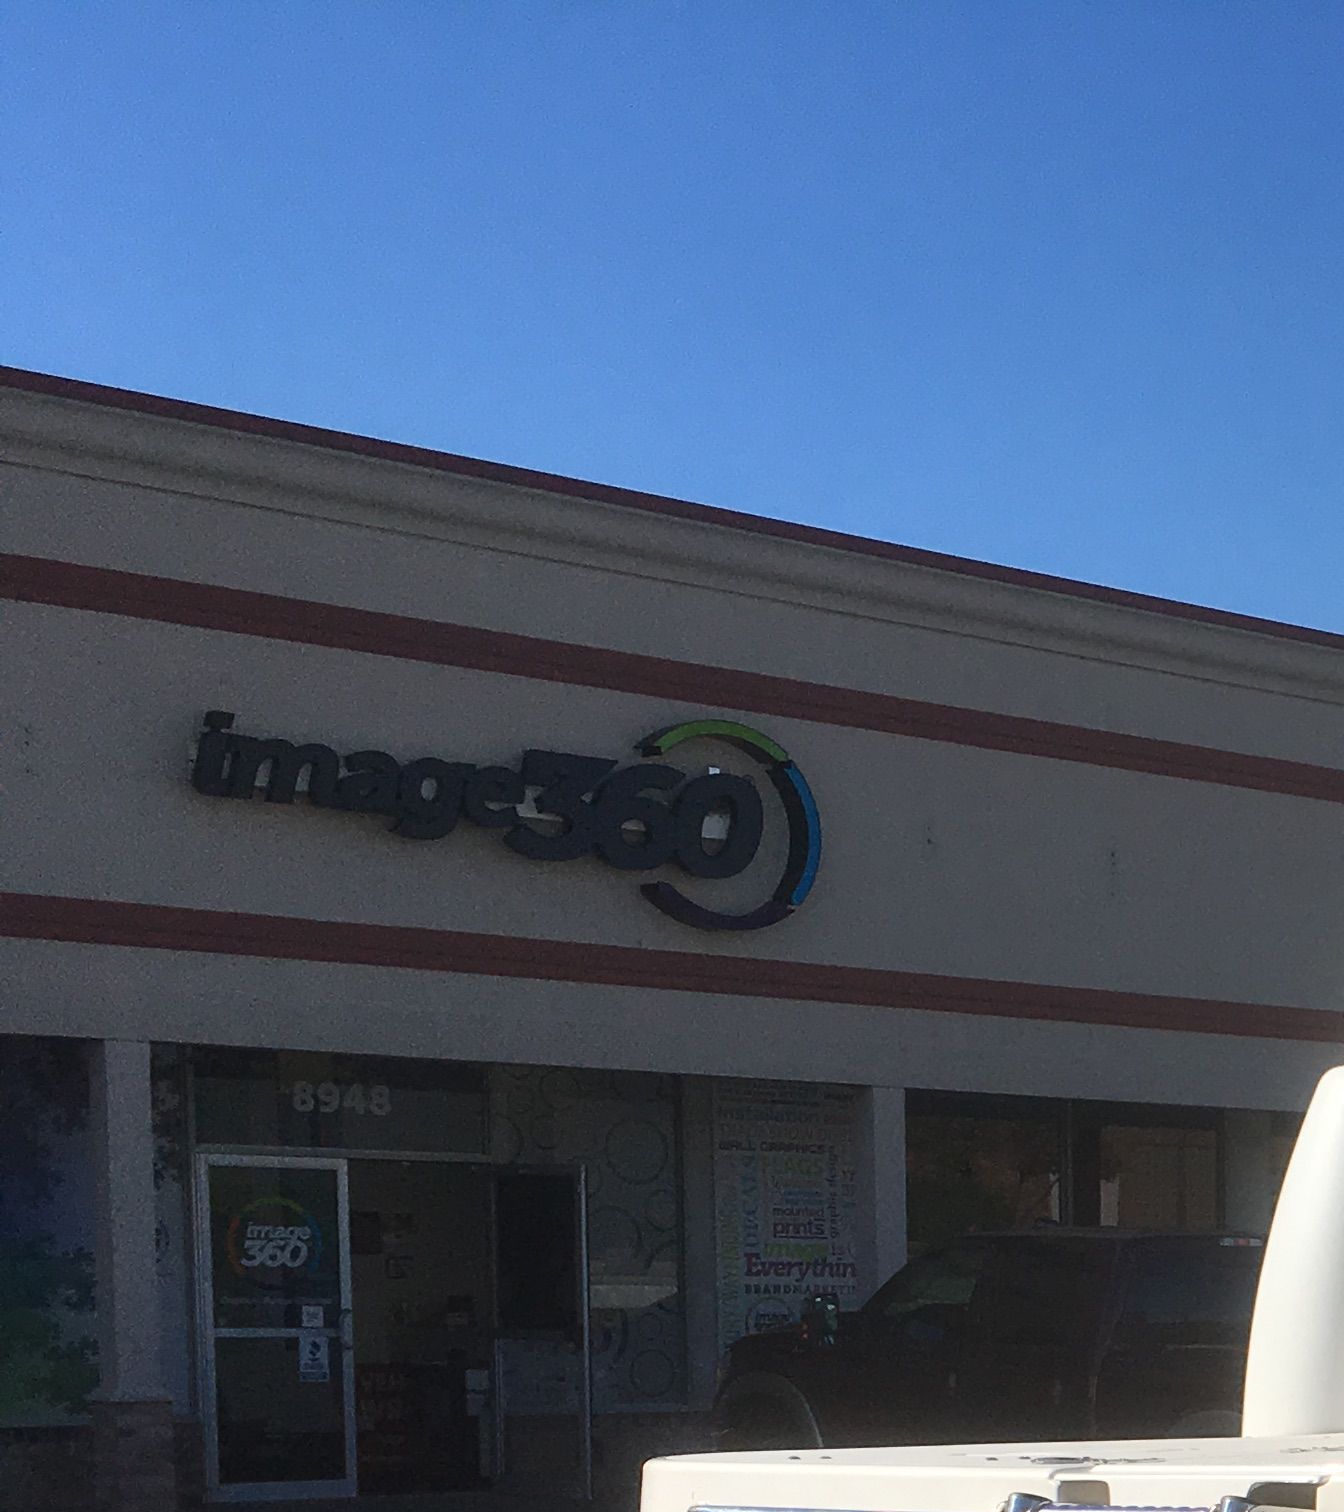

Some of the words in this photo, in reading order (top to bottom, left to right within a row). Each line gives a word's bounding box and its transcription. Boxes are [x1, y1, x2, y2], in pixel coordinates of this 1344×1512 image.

[191, 710, 762, 879] image360
[292, 1081, 391, 1116] 8948
[245, 1221, 312, 1241] image
[772, 1219, 826, 1239] prints
[240, 1240, 309, 1268] 360
